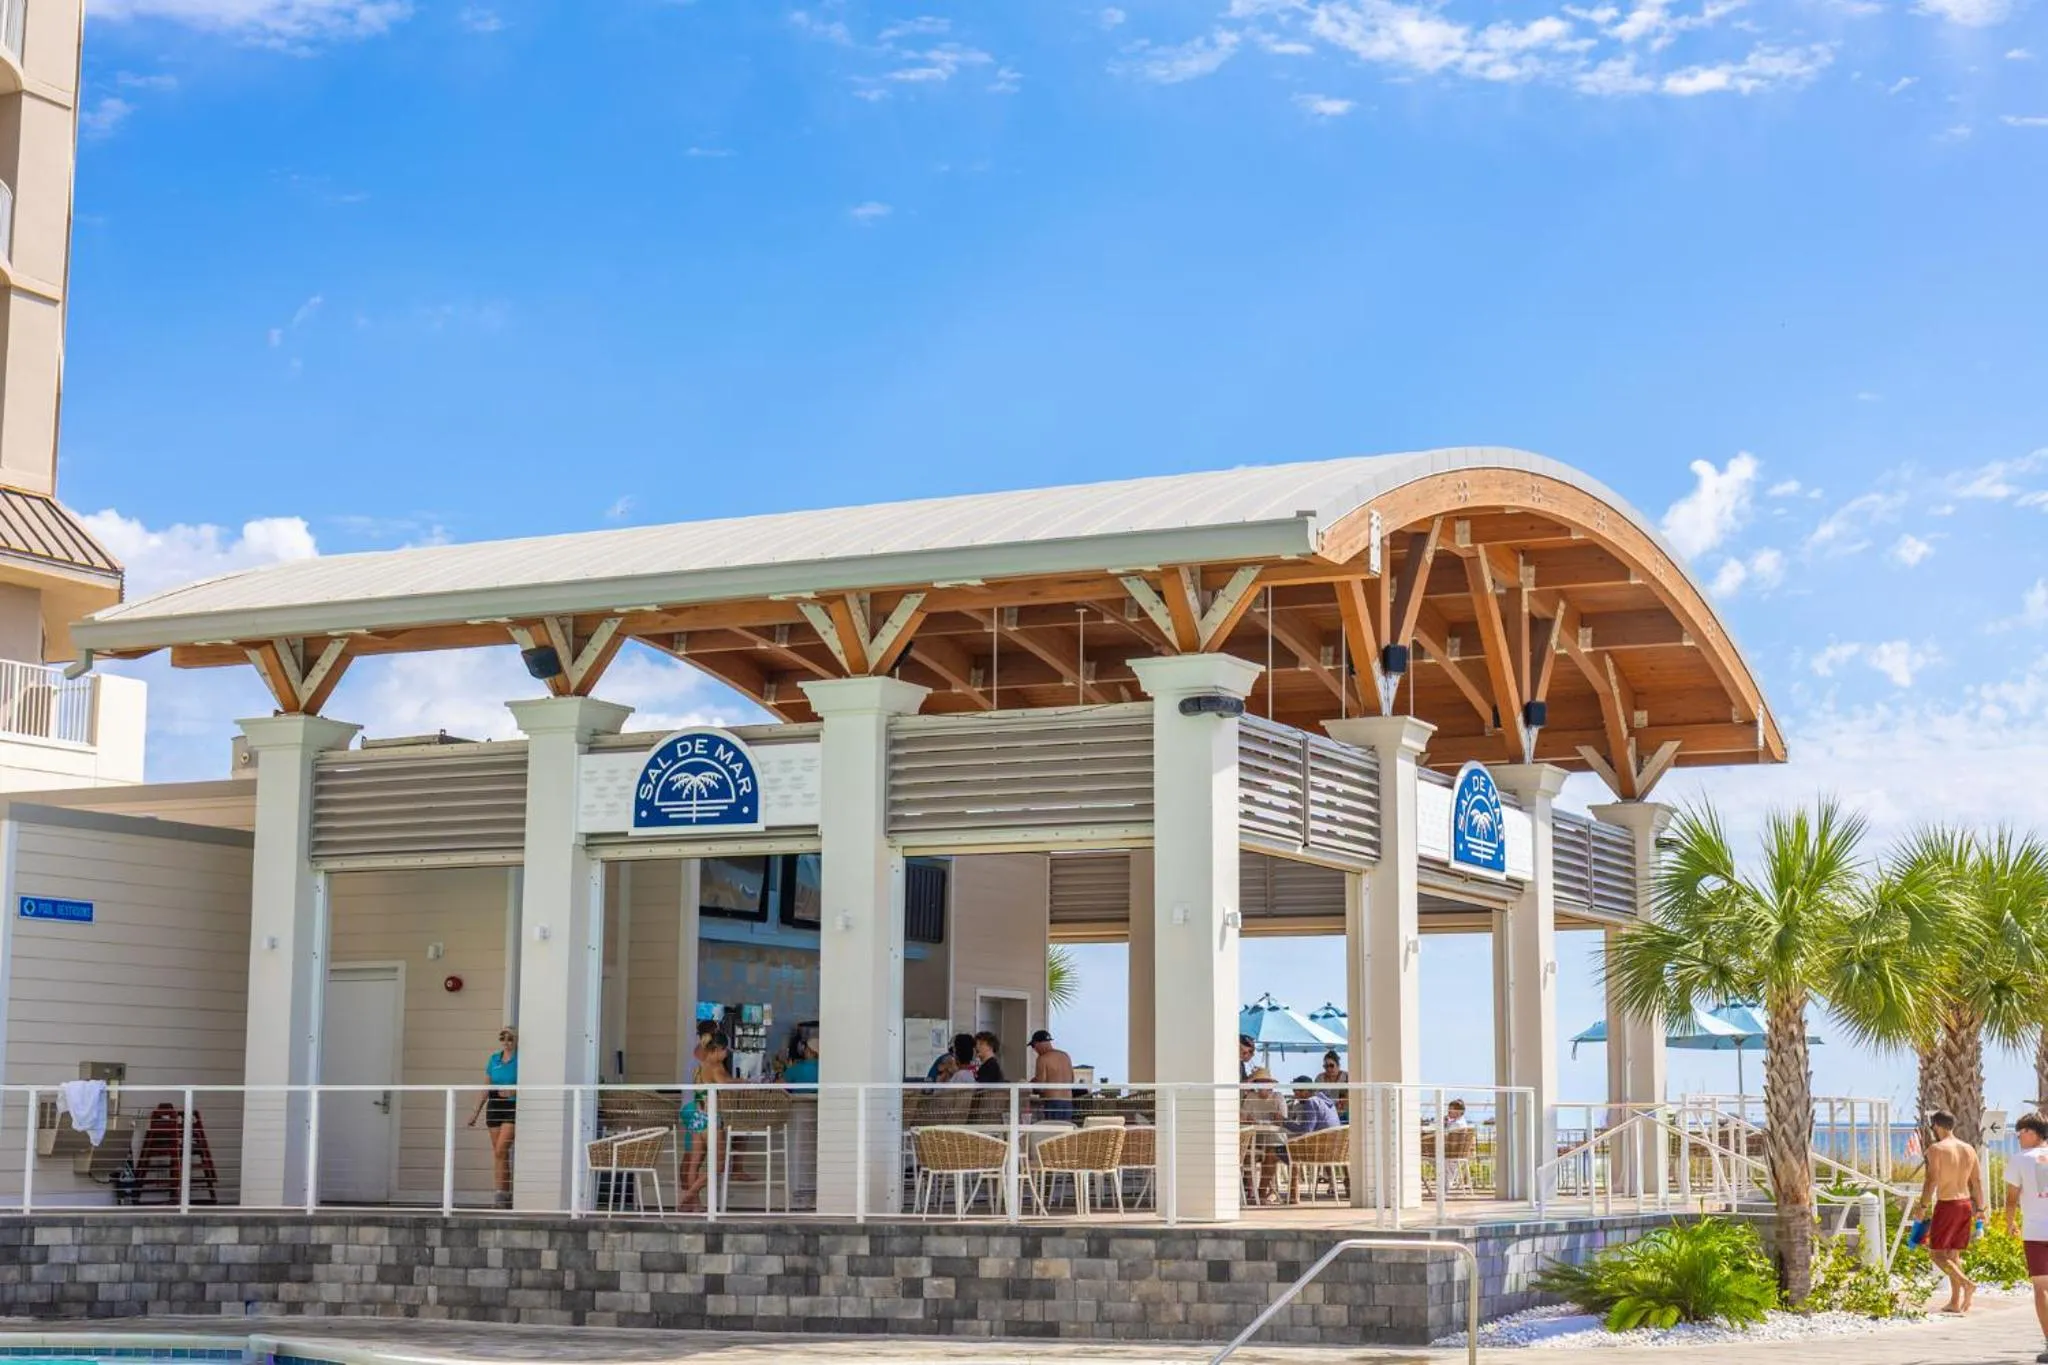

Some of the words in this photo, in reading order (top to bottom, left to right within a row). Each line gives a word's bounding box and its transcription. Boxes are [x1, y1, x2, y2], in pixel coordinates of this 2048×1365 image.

[639, 757, 673, 801] SAL
[676, 739, 709, 758] DE
[714, 743, 752, 797] MAR
[1472, 775, 1487, 793] DE
